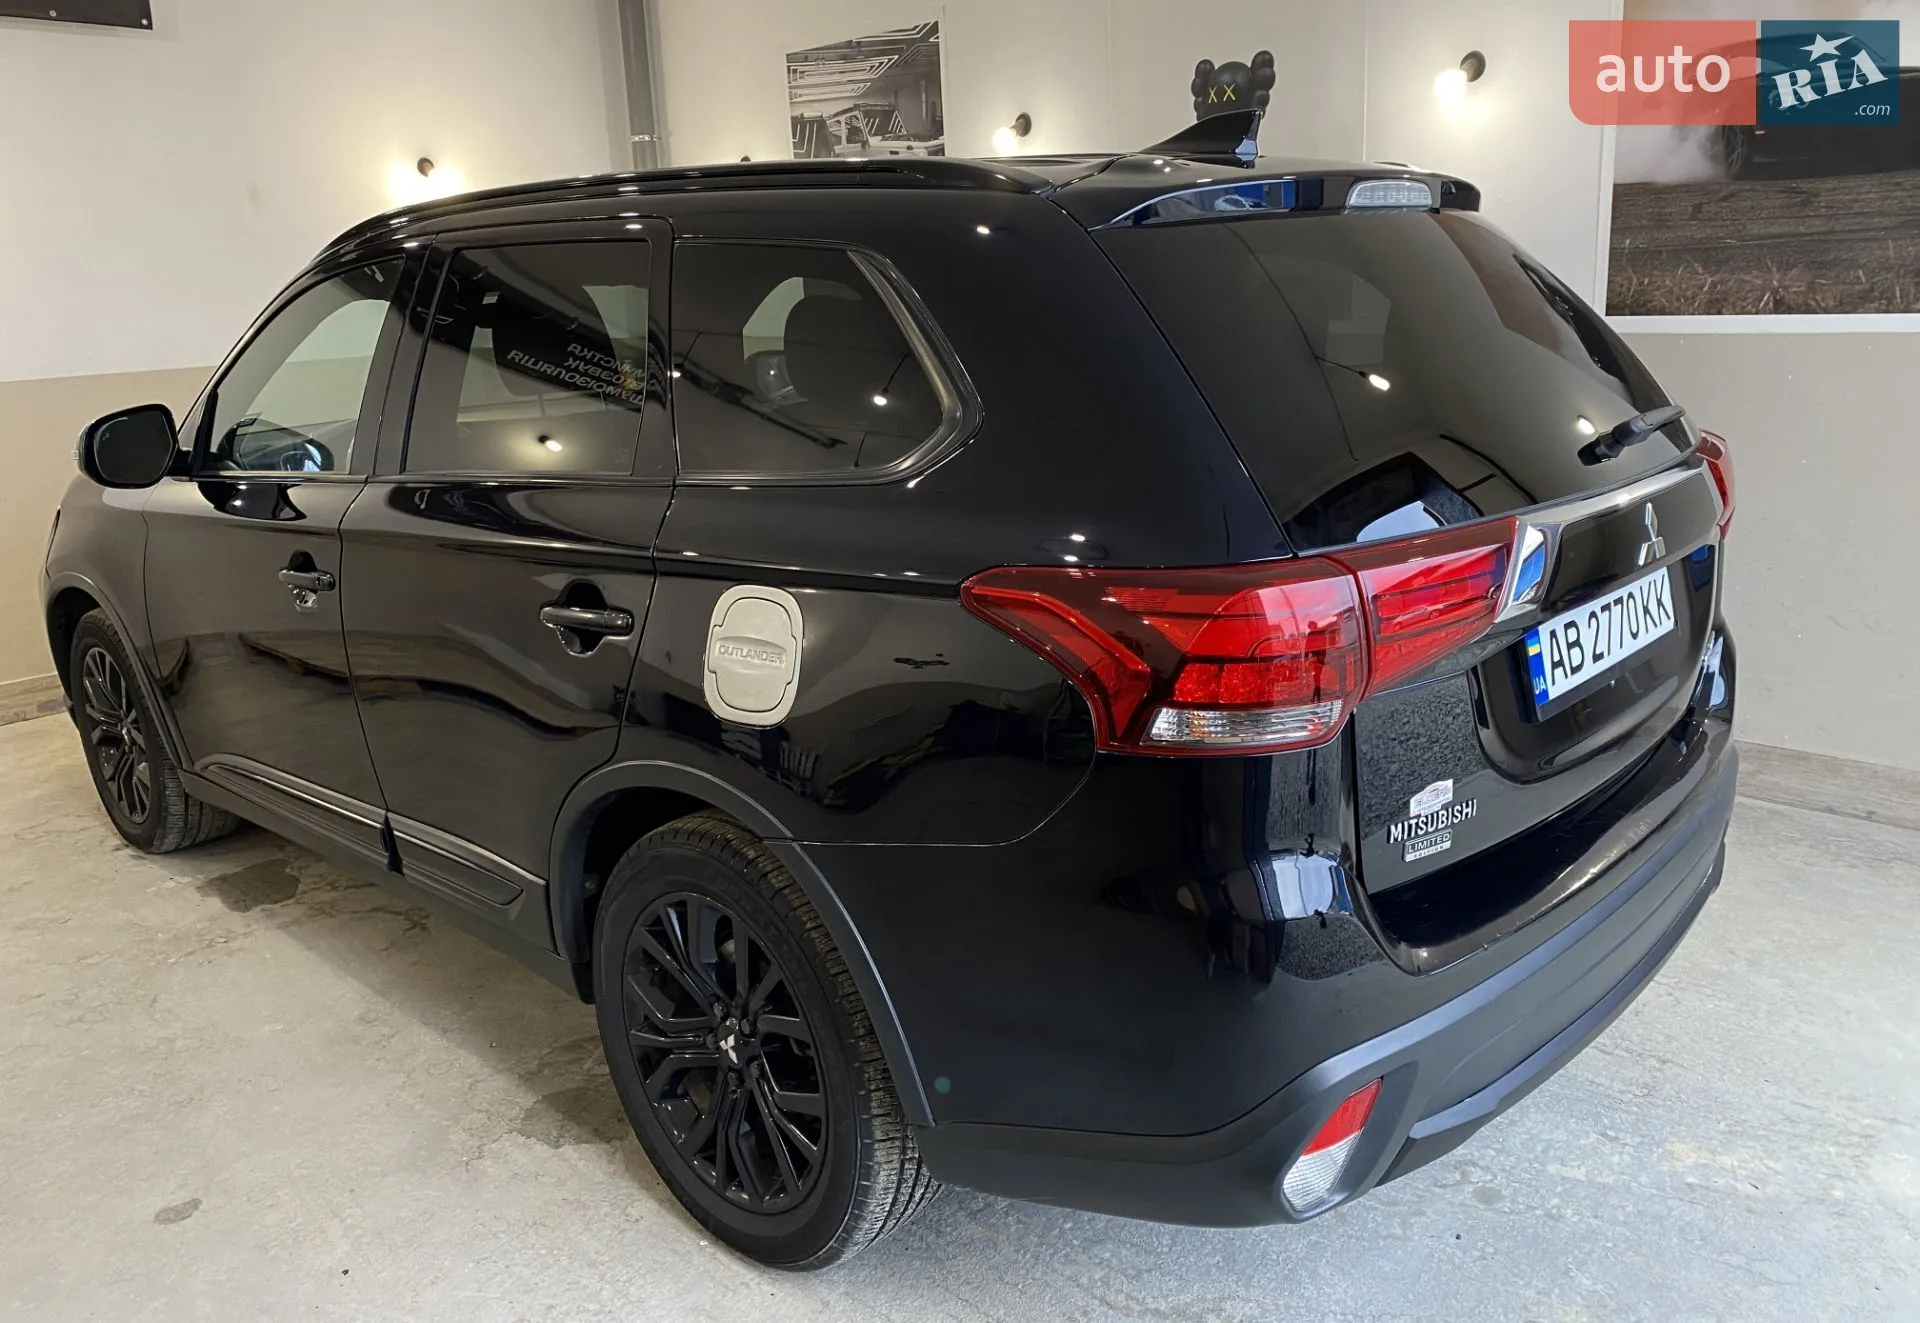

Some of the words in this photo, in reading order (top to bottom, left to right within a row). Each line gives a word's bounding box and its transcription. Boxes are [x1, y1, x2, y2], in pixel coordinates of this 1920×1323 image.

[1549, 619, 1585, 686] AB
[1587, 591, 1640, 664] 2770
[1639, 573, 1671, 634] KK
[718, 644, 785, 665] OUTLANDER
[1533, 676, 1547, 694] UA
[1388, 798, 1477, 844] MITSUBISHI
[1408, 832, 1451, 853] LIMITED
